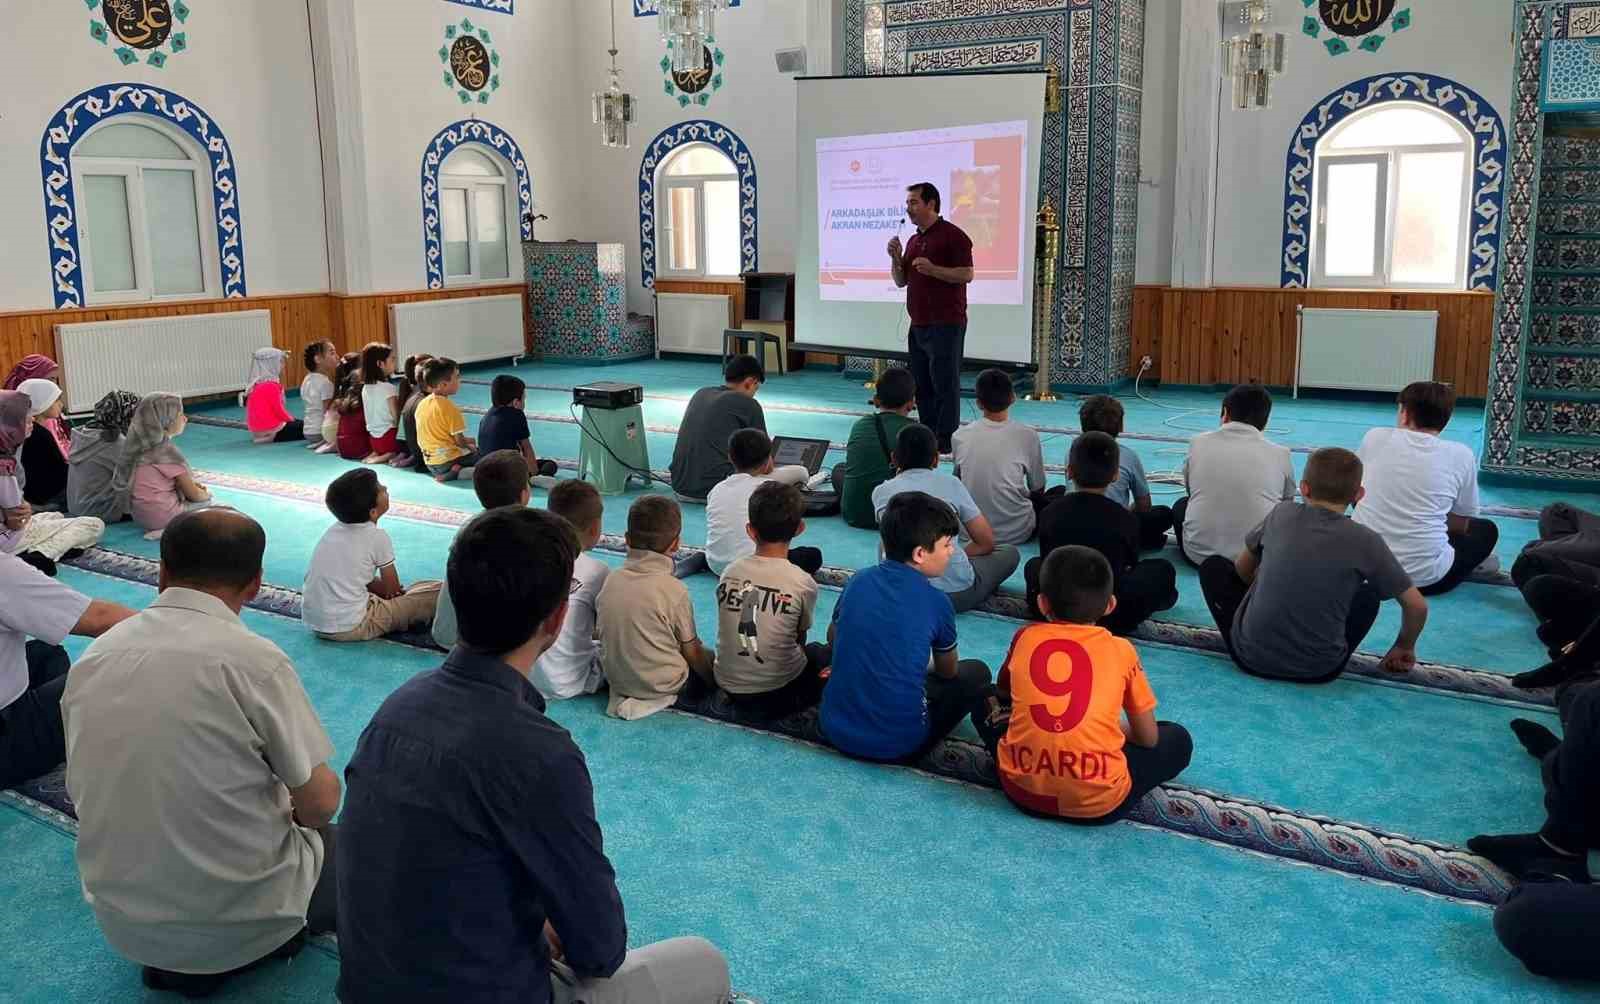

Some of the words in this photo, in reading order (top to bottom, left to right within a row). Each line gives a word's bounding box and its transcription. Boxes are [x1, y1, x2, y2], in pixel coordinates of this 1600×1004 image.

[831, 221, 861, 230] AKRAN
[1029, 638, 1093, 733] 9
[1010, 745, 1109, 781] ICARDI
